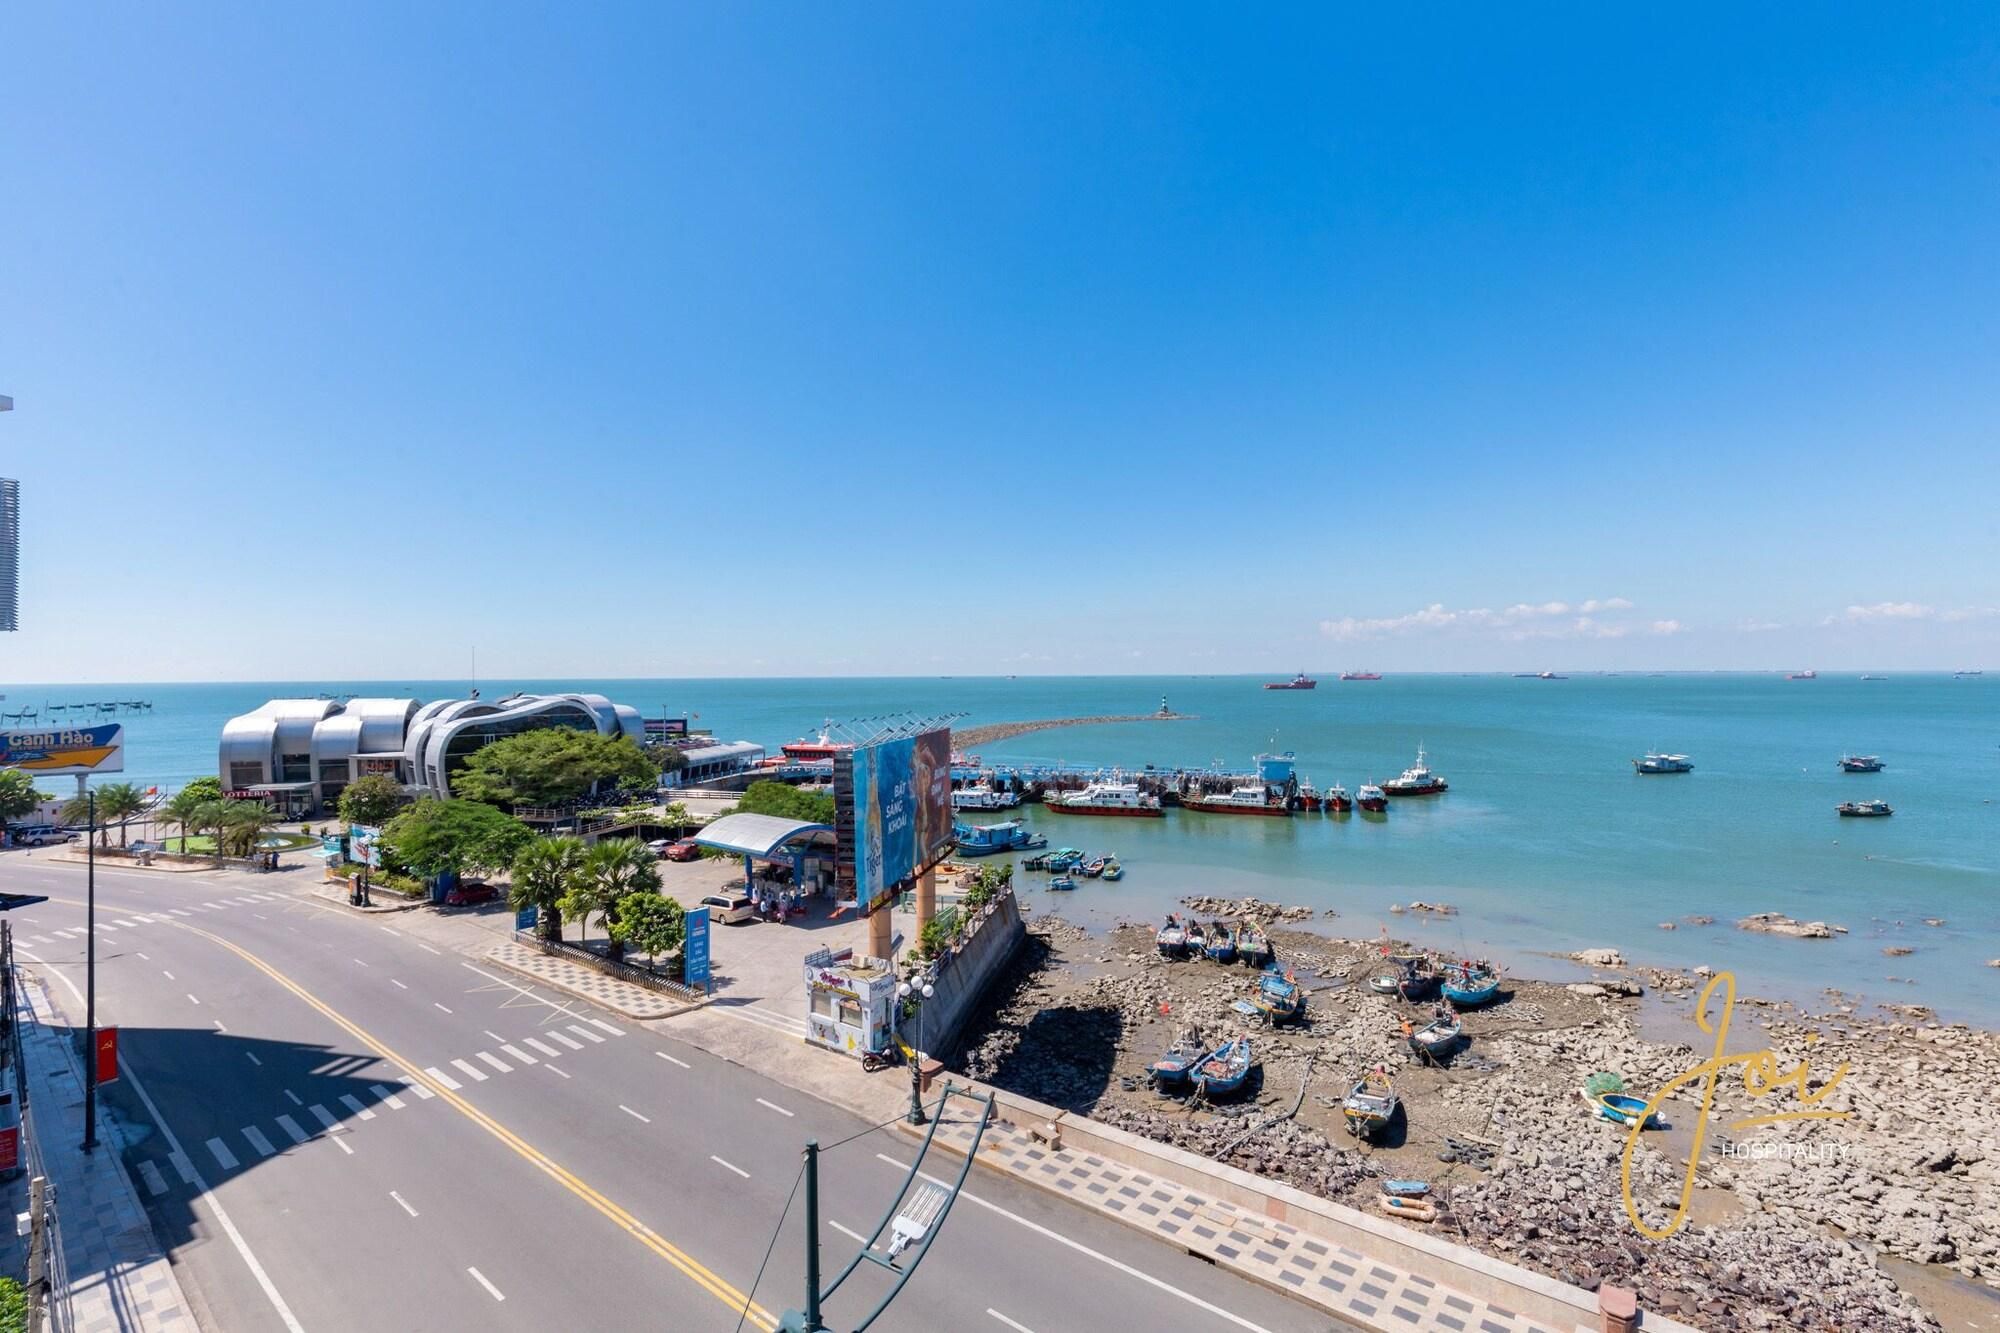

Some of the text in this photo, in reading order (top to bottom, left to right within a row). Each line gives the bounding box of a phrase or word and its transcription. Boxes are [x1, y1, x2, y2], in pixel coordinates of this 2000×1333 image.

[60, 730, 94, 745] Hào
[222, 790, 271, 798] LOTTERIA
[866, 854, 881, 877] Tiger
